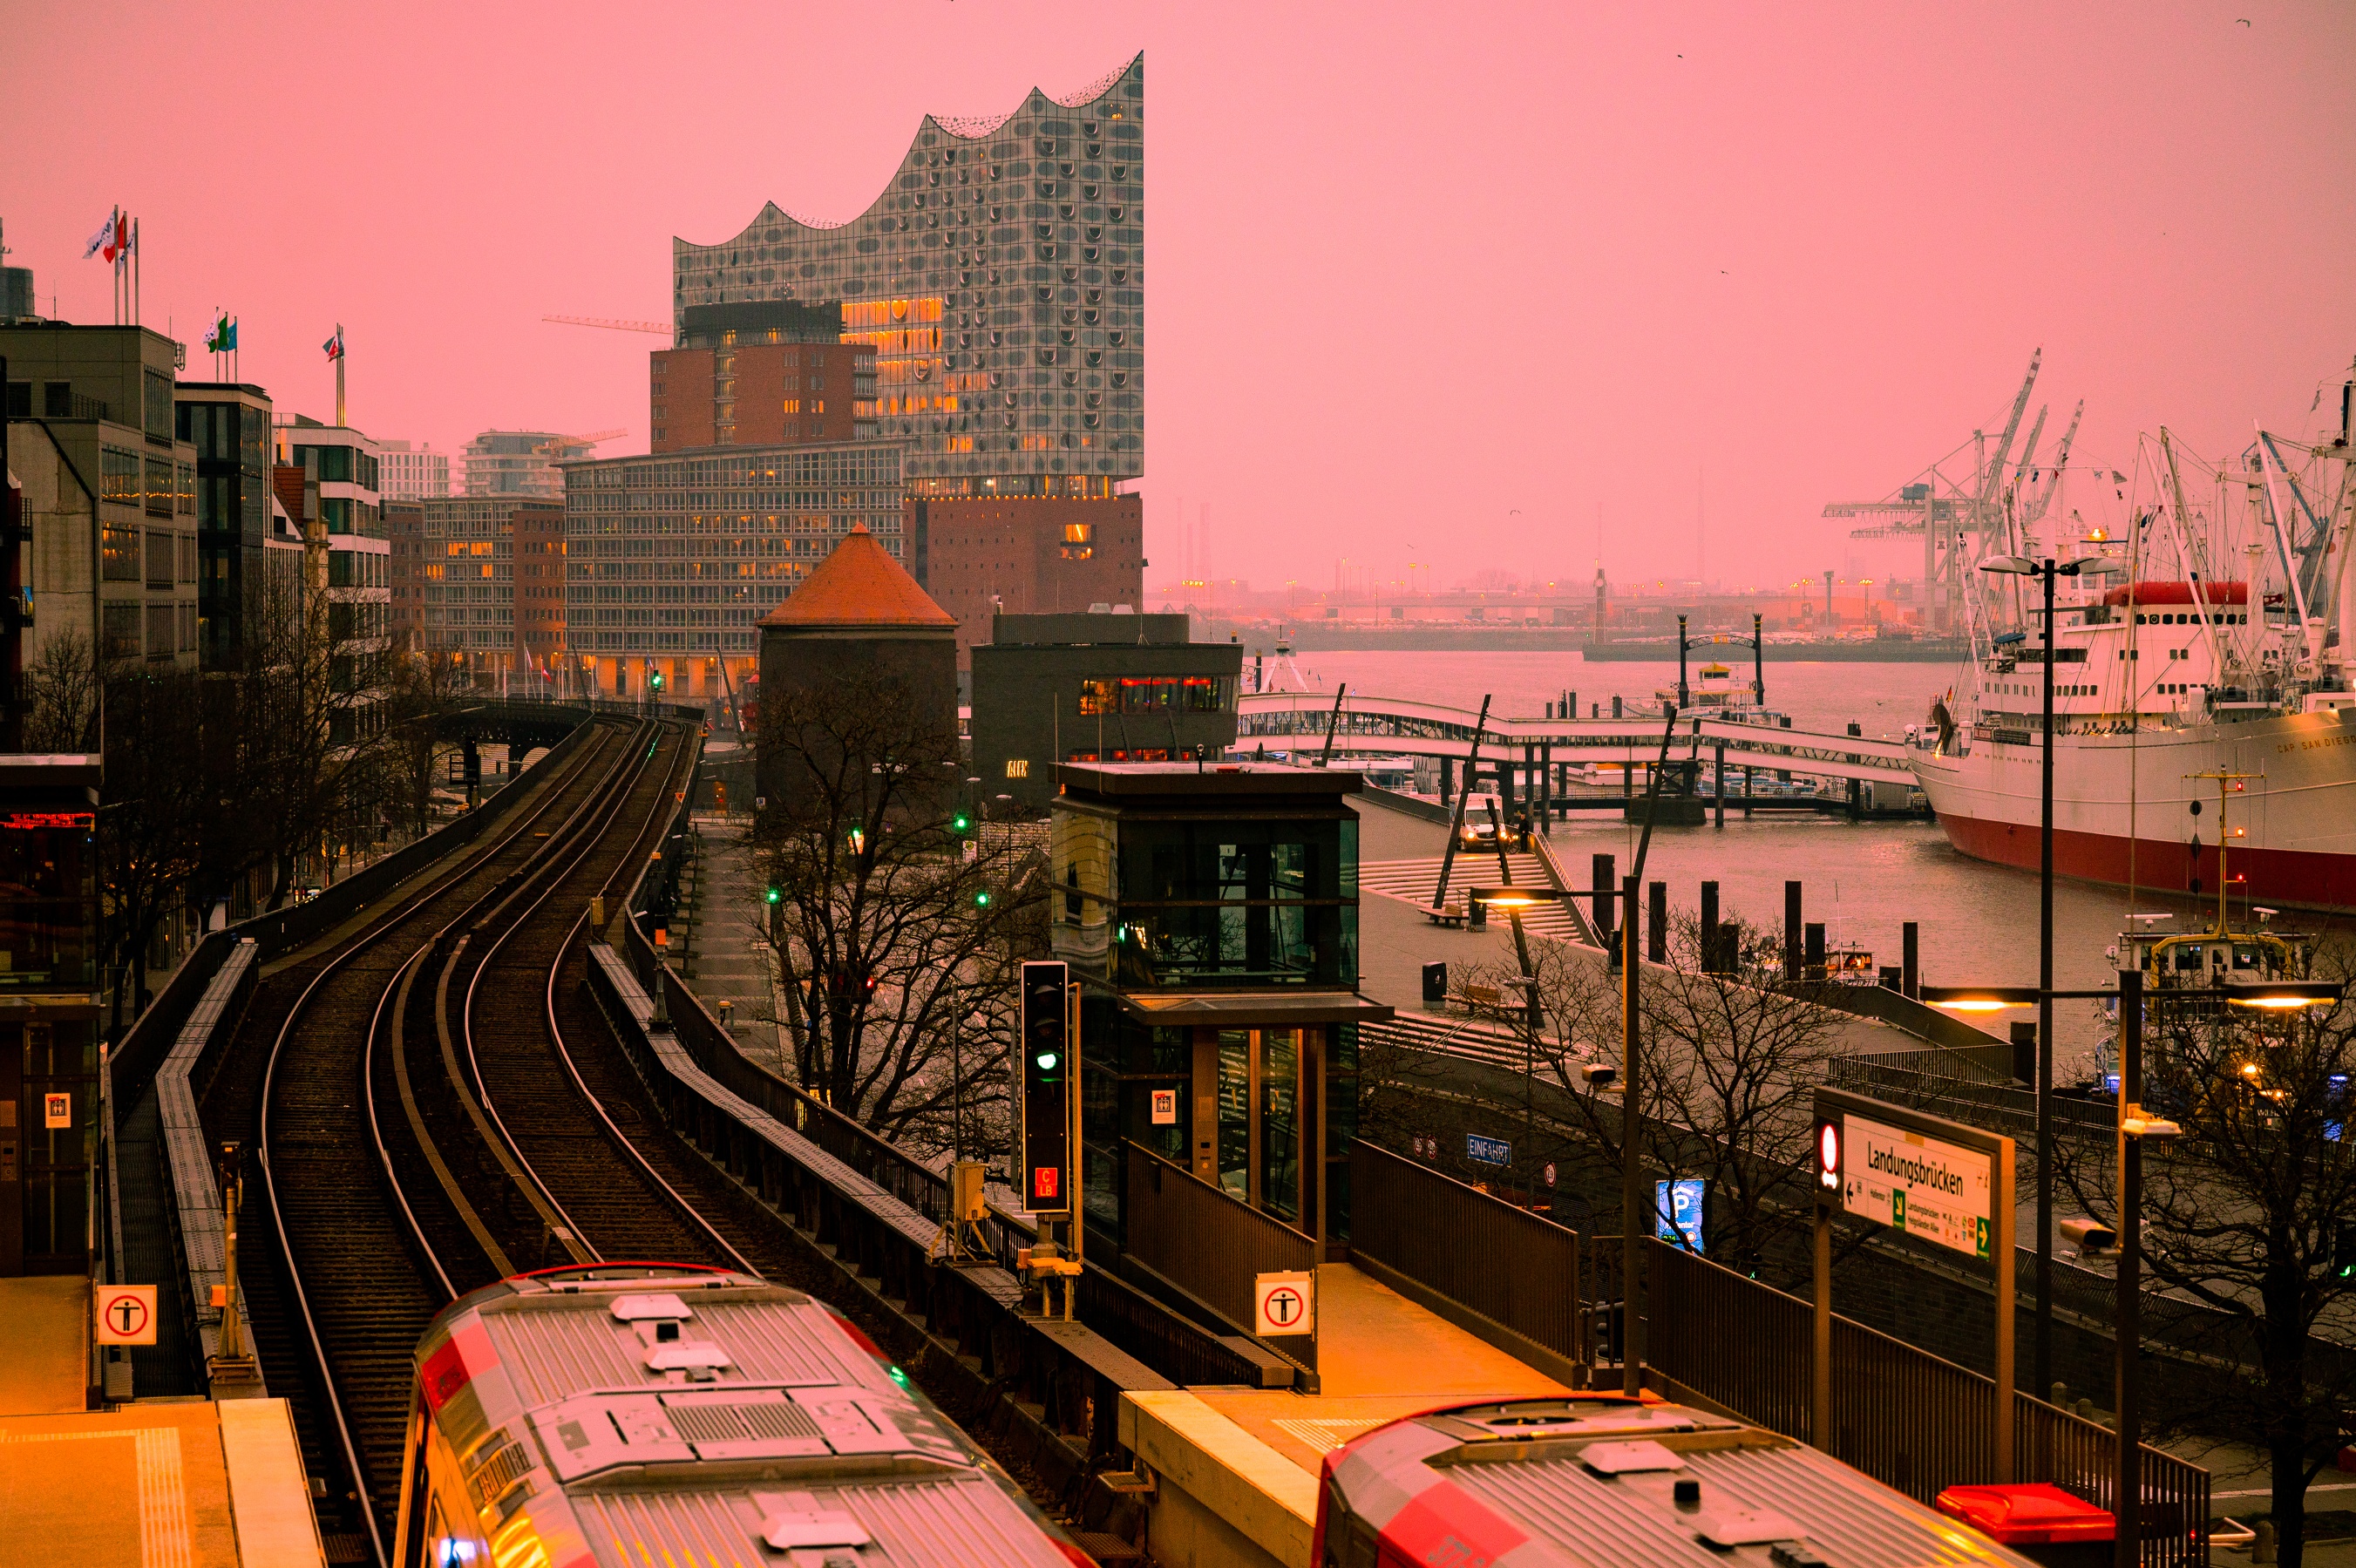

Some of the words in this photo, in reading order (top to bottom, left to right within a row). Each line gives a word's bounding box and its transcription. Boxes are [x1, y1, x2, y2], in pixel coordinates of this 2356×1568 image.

[2277, 743, 2295, 753] CAP
[2302, 738, 2321, 750] SAN
[2325, 735, 2356, 748] DIEGO
[1470, 1138, 1509, 1162] EINFAHRT
[1042, 1170, 1050, 1183] C
[1868, 1141, 1963, 1198] Landungsbrücken
[1040, 1185, 1052, 1197] LB
[1674, 1195, 1689, 1218] P
